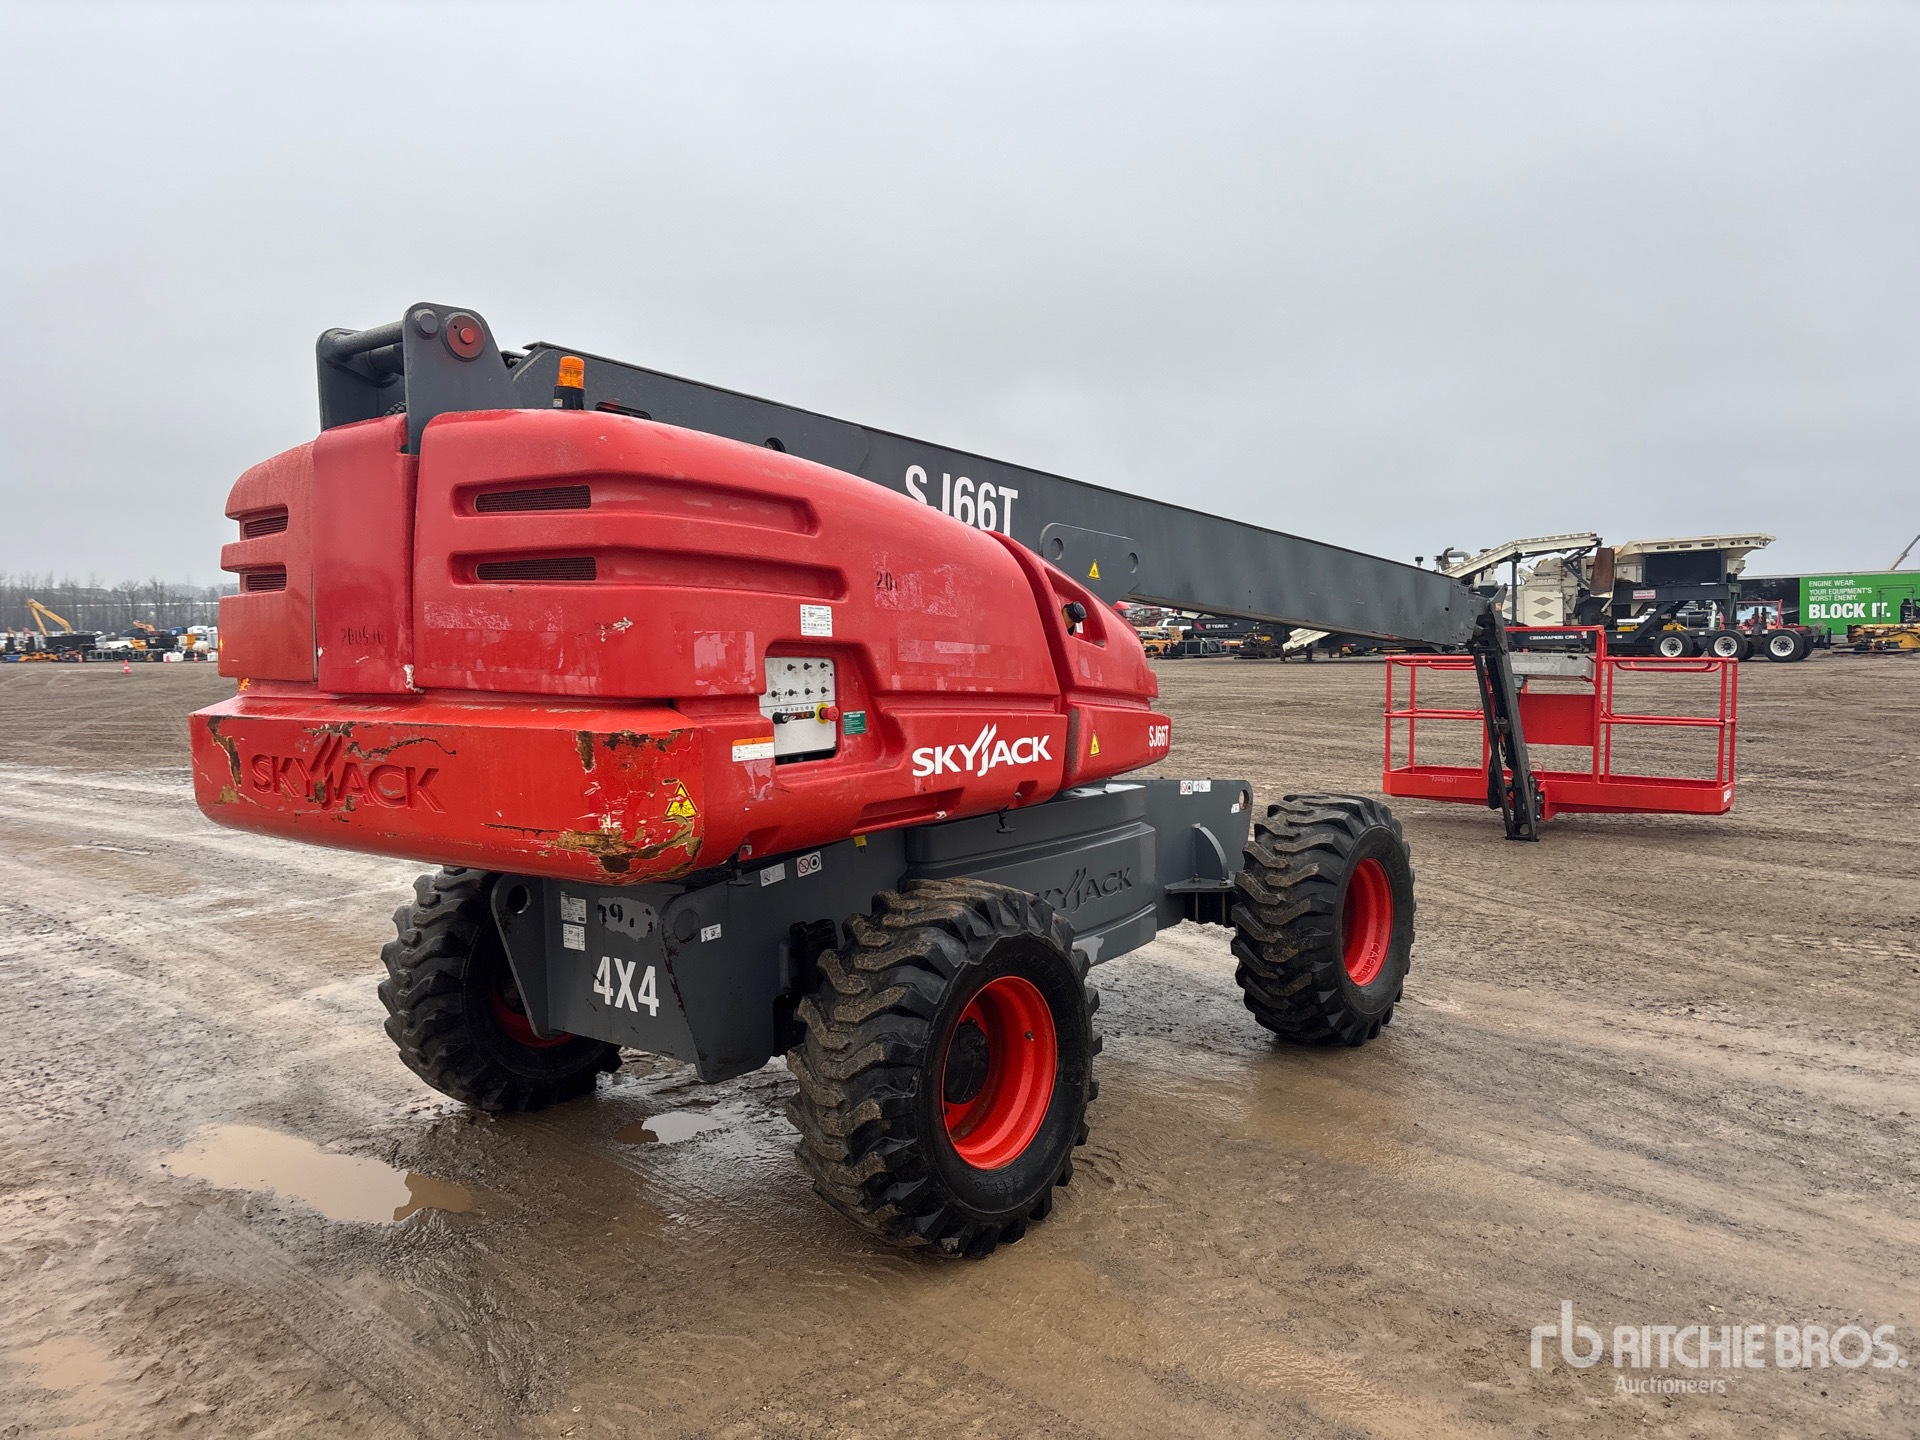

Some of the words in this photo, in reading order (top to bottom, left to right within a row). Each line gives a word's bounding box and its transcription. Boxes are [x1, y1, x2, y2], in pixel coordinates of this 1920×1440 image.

[905, 464, 1019, 537] SJ66T
[1808, 603, 1866, 619] BLOCK
[1809, 588, 1827, 596] YOUR
[1828, 587, 1873, 595] EQUIPMENT'S
[1833, 594, 1859, 602] ENEMY.
[911, 722, 1053, 778] SKYJACK
[1148, 724, 1169, 748] SJ66T
[250, 732, 448, 815] SKYJACK
[1033, 867, 1132, 914] YJACK
[593, 955, 660, 1017] 4X4
